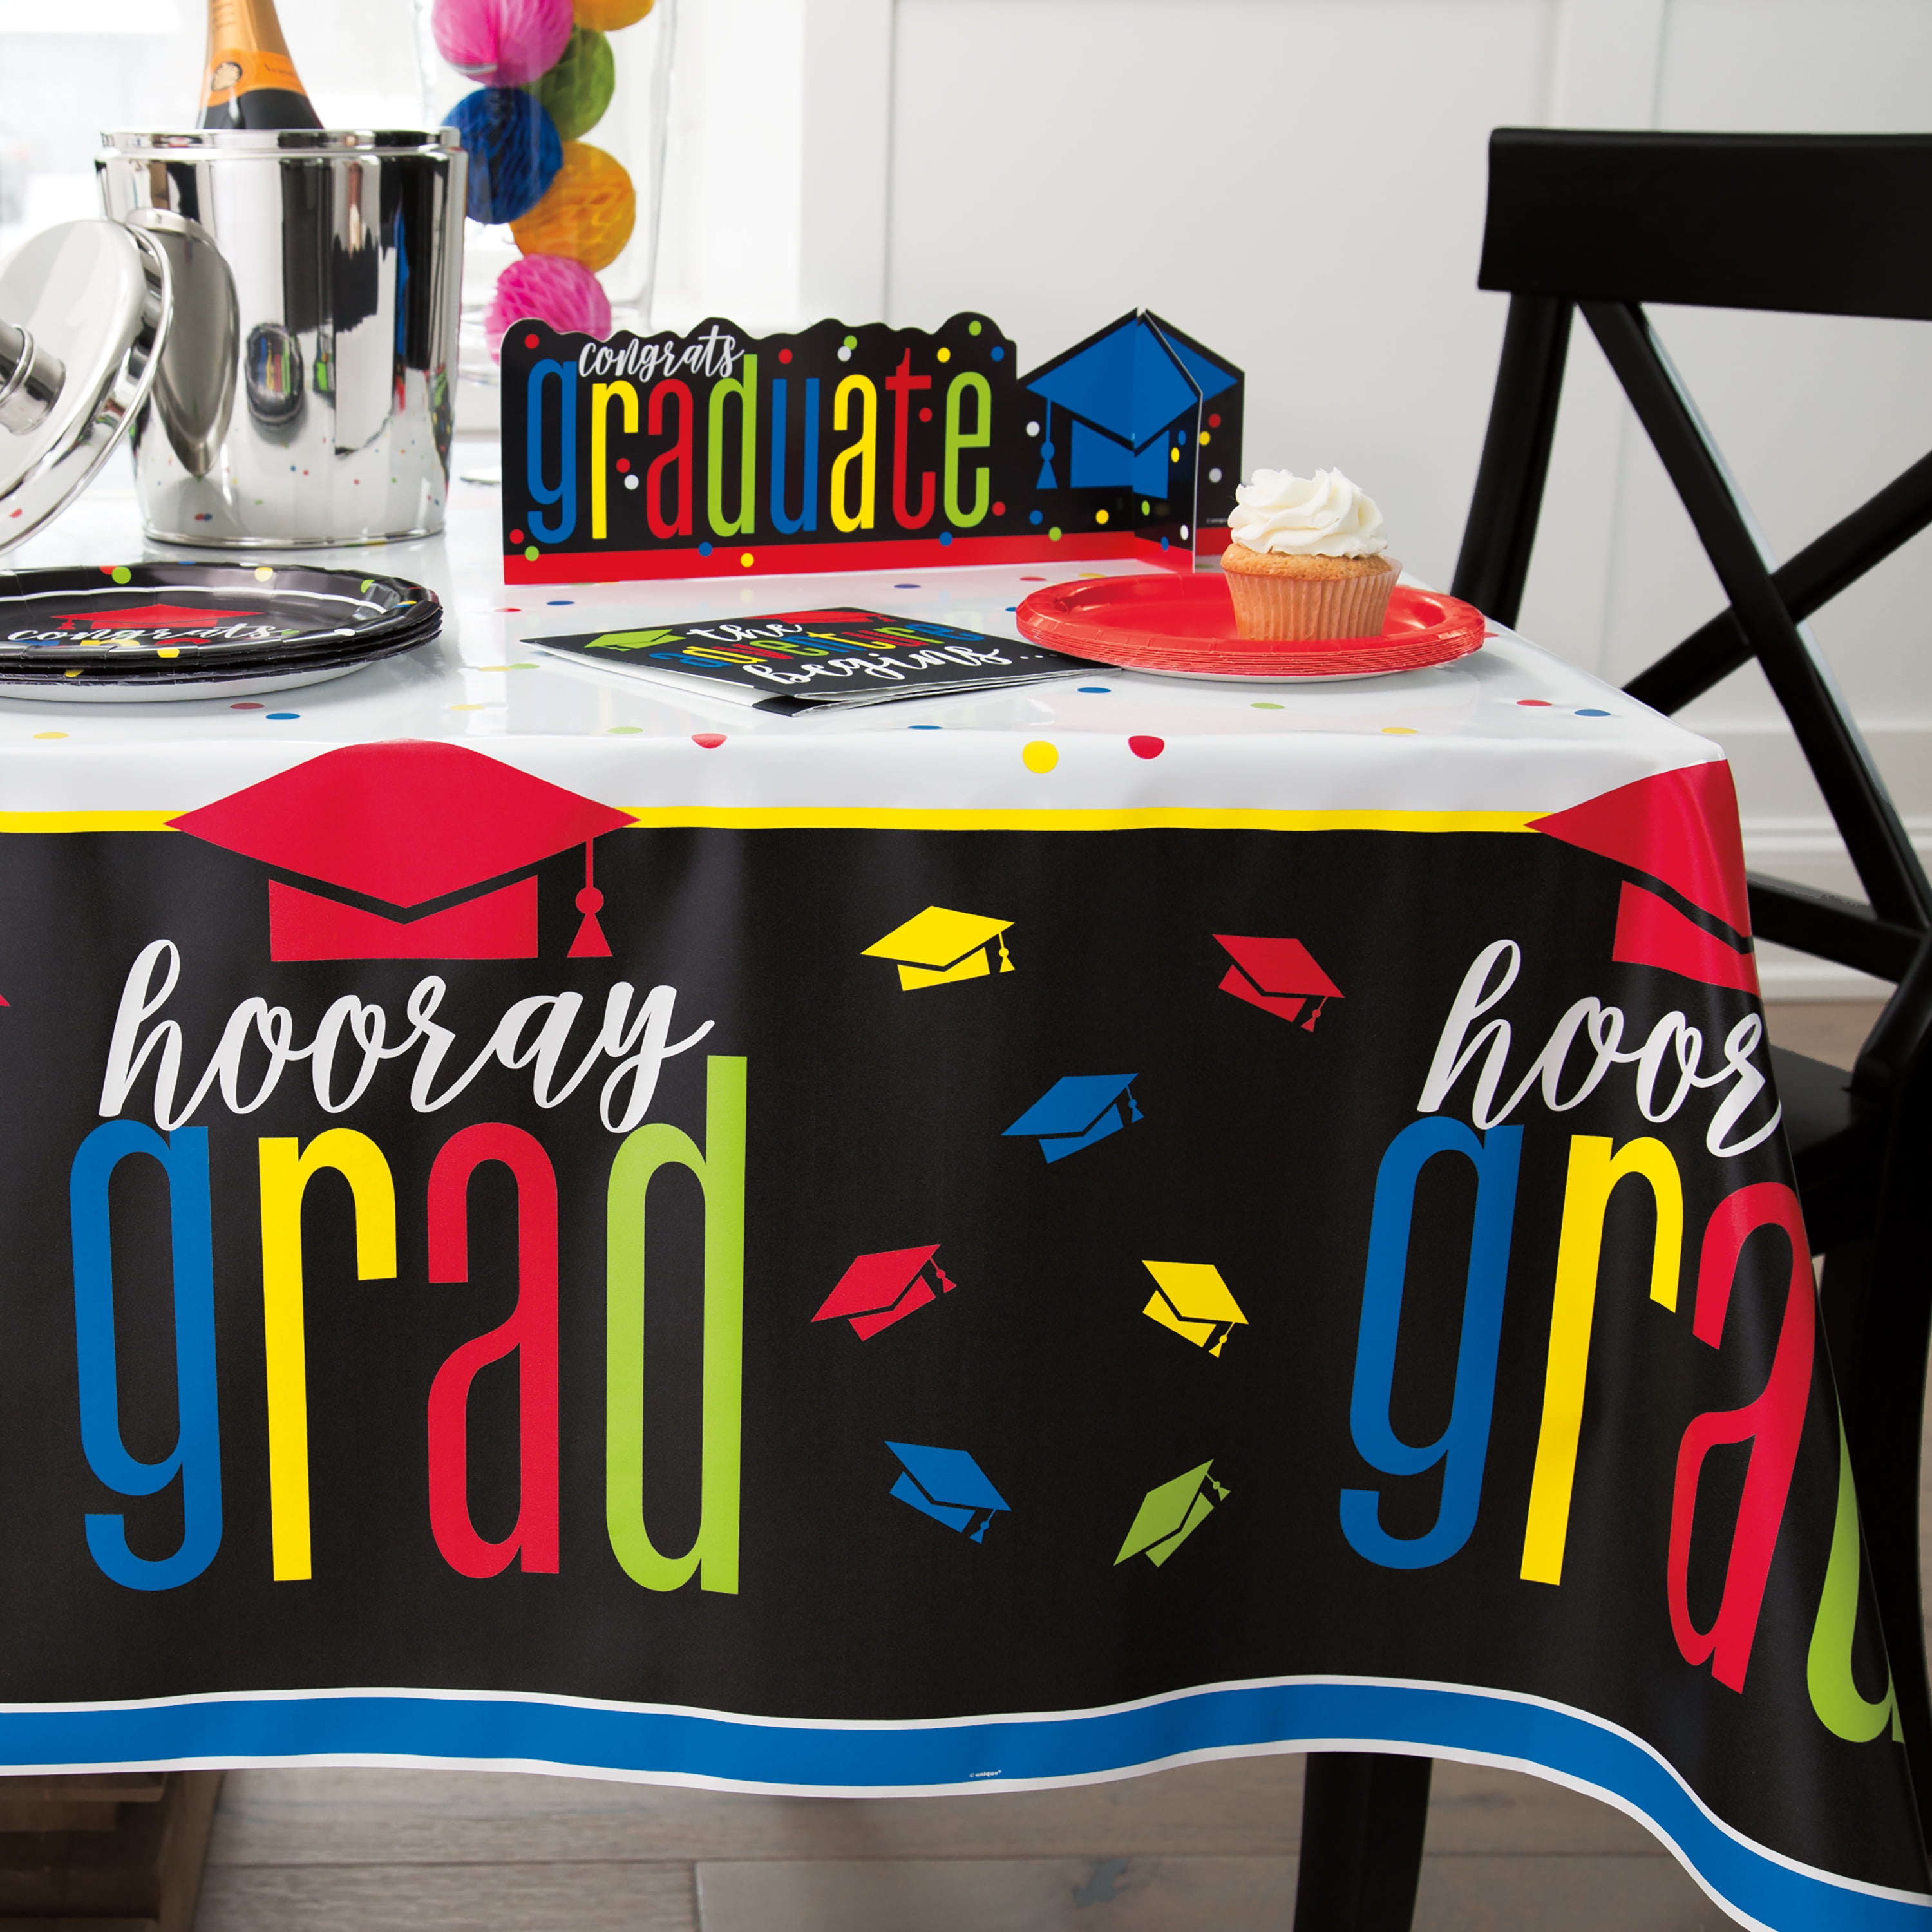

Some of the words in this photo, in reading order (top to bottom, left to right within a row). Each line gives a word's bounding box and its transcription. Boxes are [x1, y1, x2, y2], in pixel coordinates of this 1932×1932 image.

[578, 325, 745, 383] congrats
[527, 348, 992, 544] graduate
[7, 623, 296, 641] congrats
[649, 623, 985, 668] adventure
[686, 623, 803, 642] the
[98, 939, 715, 1133] hooray
[69, 1056, 748, 1595] grad
